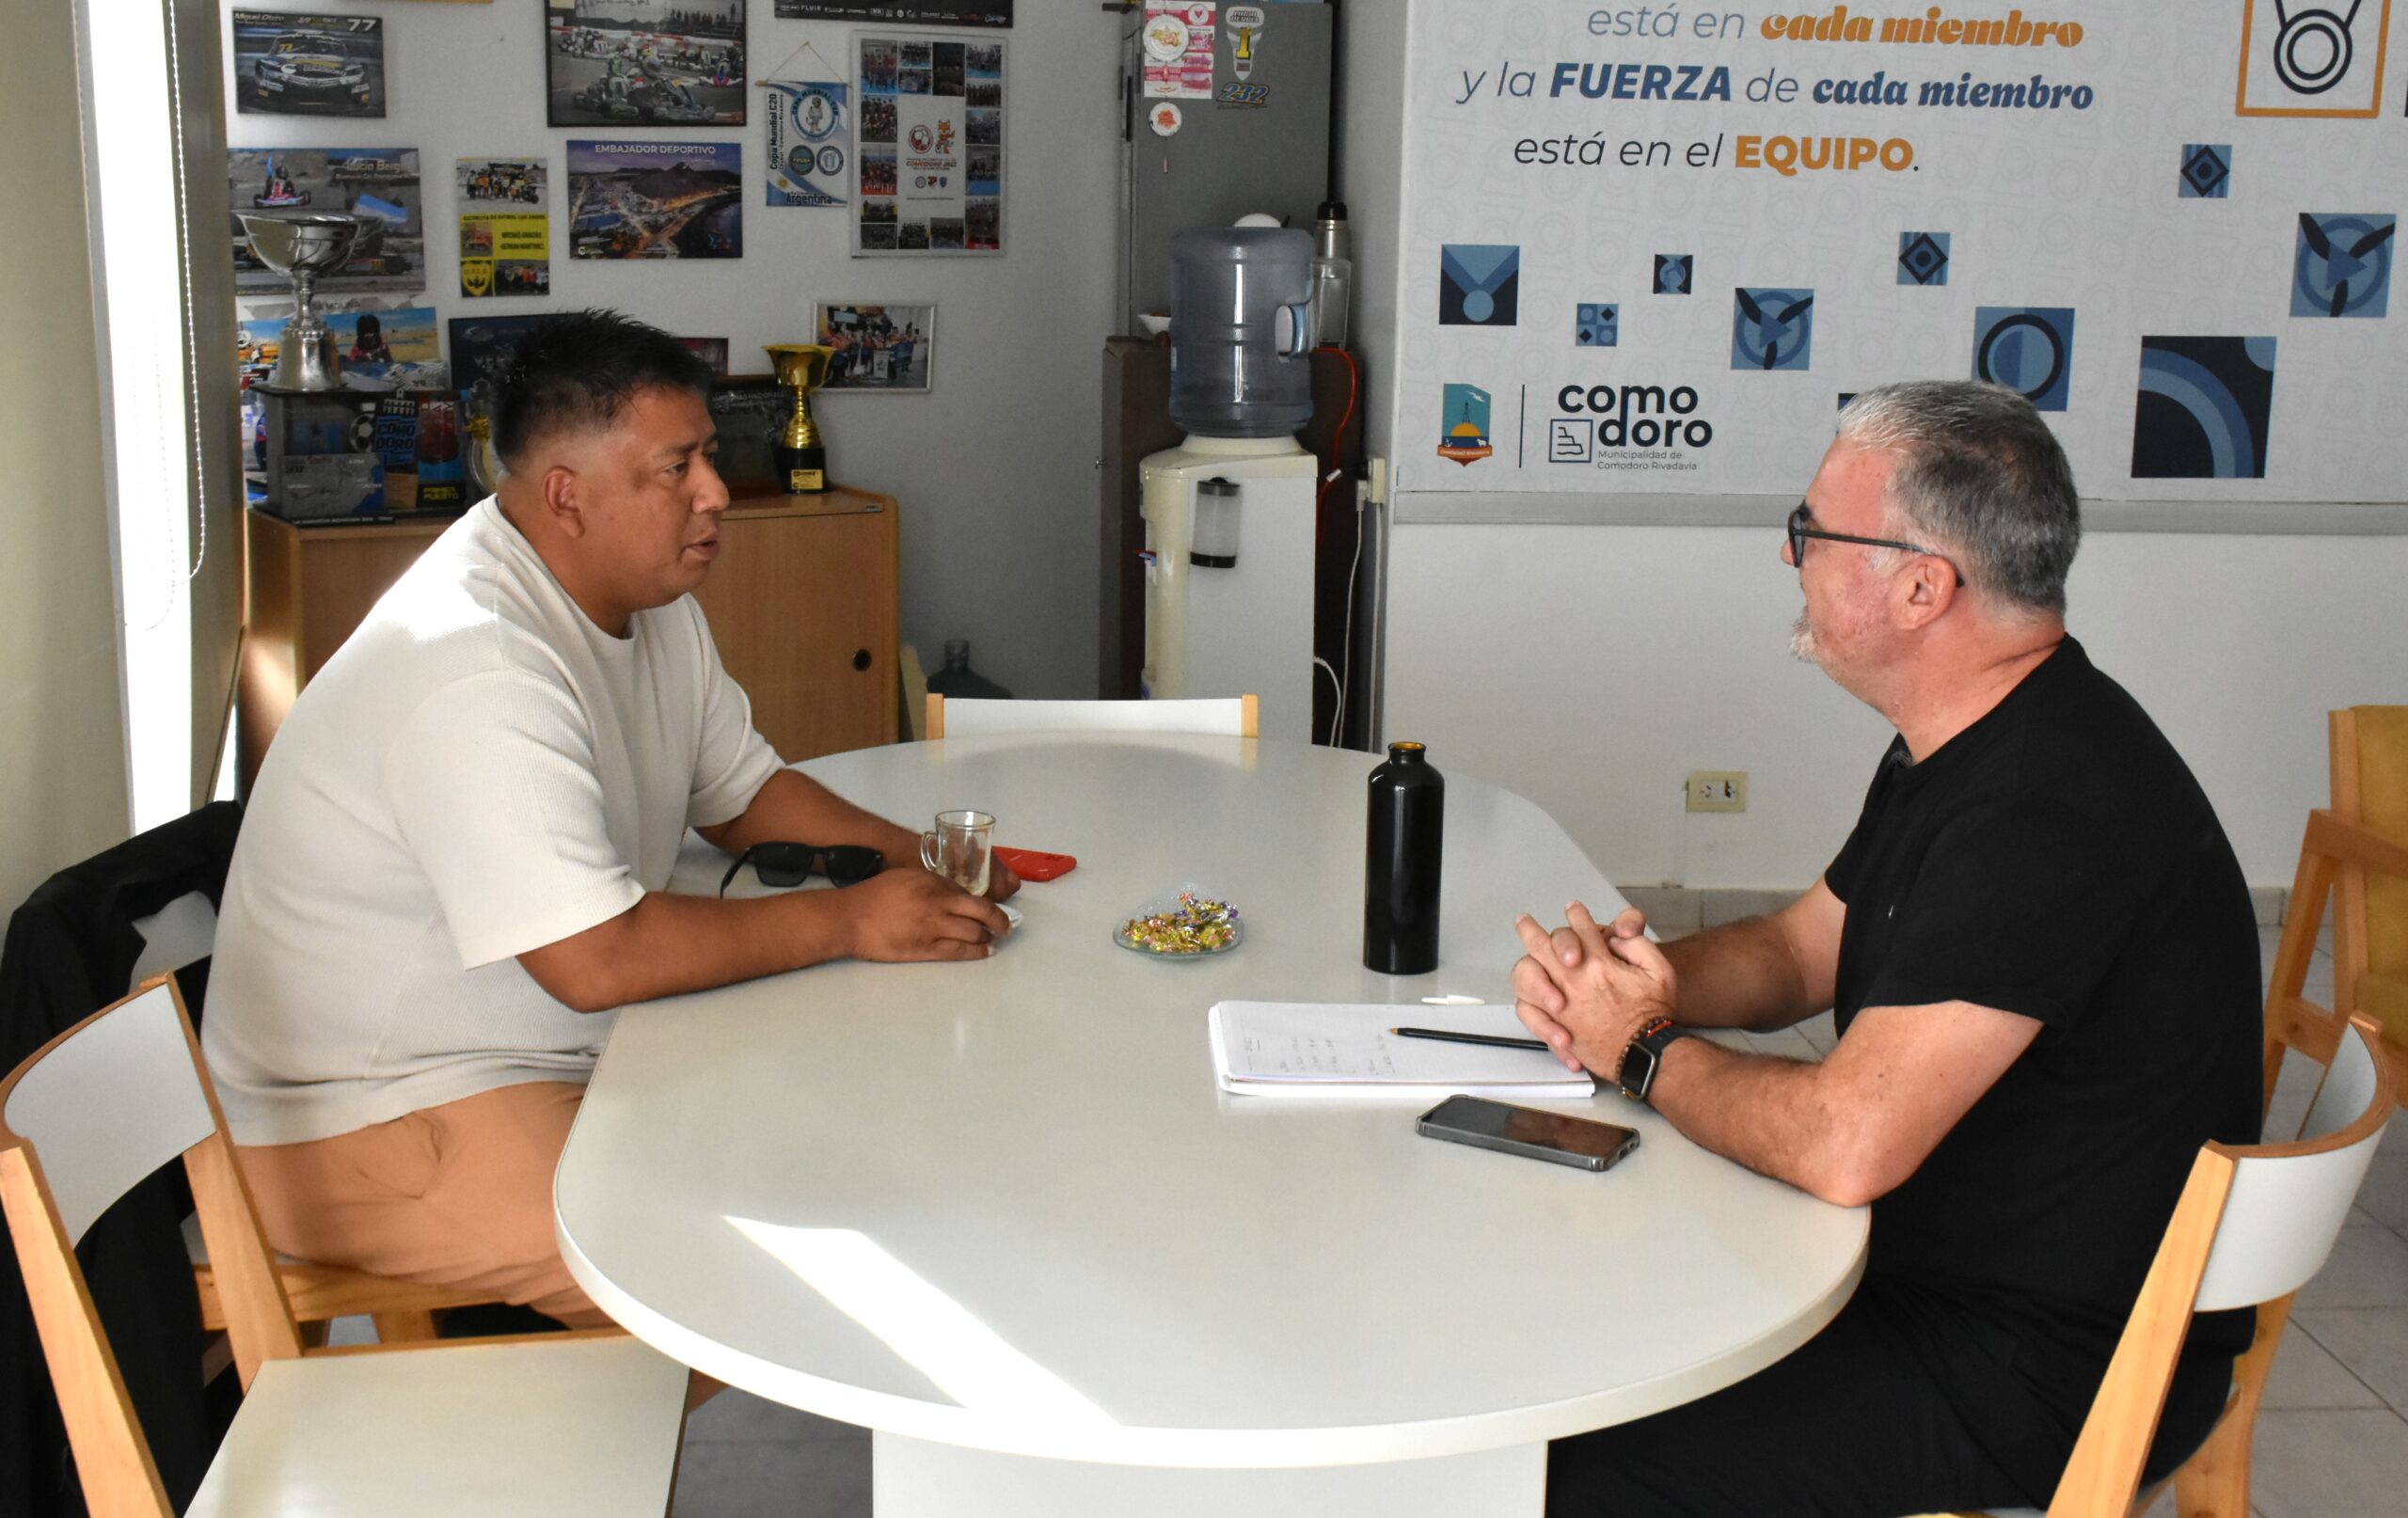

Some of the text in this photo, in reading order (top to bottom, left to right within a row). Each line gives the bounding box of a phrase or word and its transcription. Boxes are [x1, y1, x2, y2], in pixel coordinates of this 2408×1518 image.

[347, 18, 376, 32] 77
[1588, 6, 2083, 47] está en cada miembro
[1217, 82, 1270, 104] 232
[1455, 61, 2095, 110] y la FUERZA de cada miembro
[768, 93, 779, 170] Copa Mundial C20
[594, 144, 716, 154] EMBAJADOR DEPORTIVO
[1513, 131, 1920, 177] está en el EQUIPO.
[786, 192, 832, 205] Argentina
[1558, 385, 1699, 415] como
[1597, 414, 1713, 448] doro
[1597, 461, 1698, 470] Comodoro Rivadavia
[1598, 451, 1683, 460] Municipalidad de
